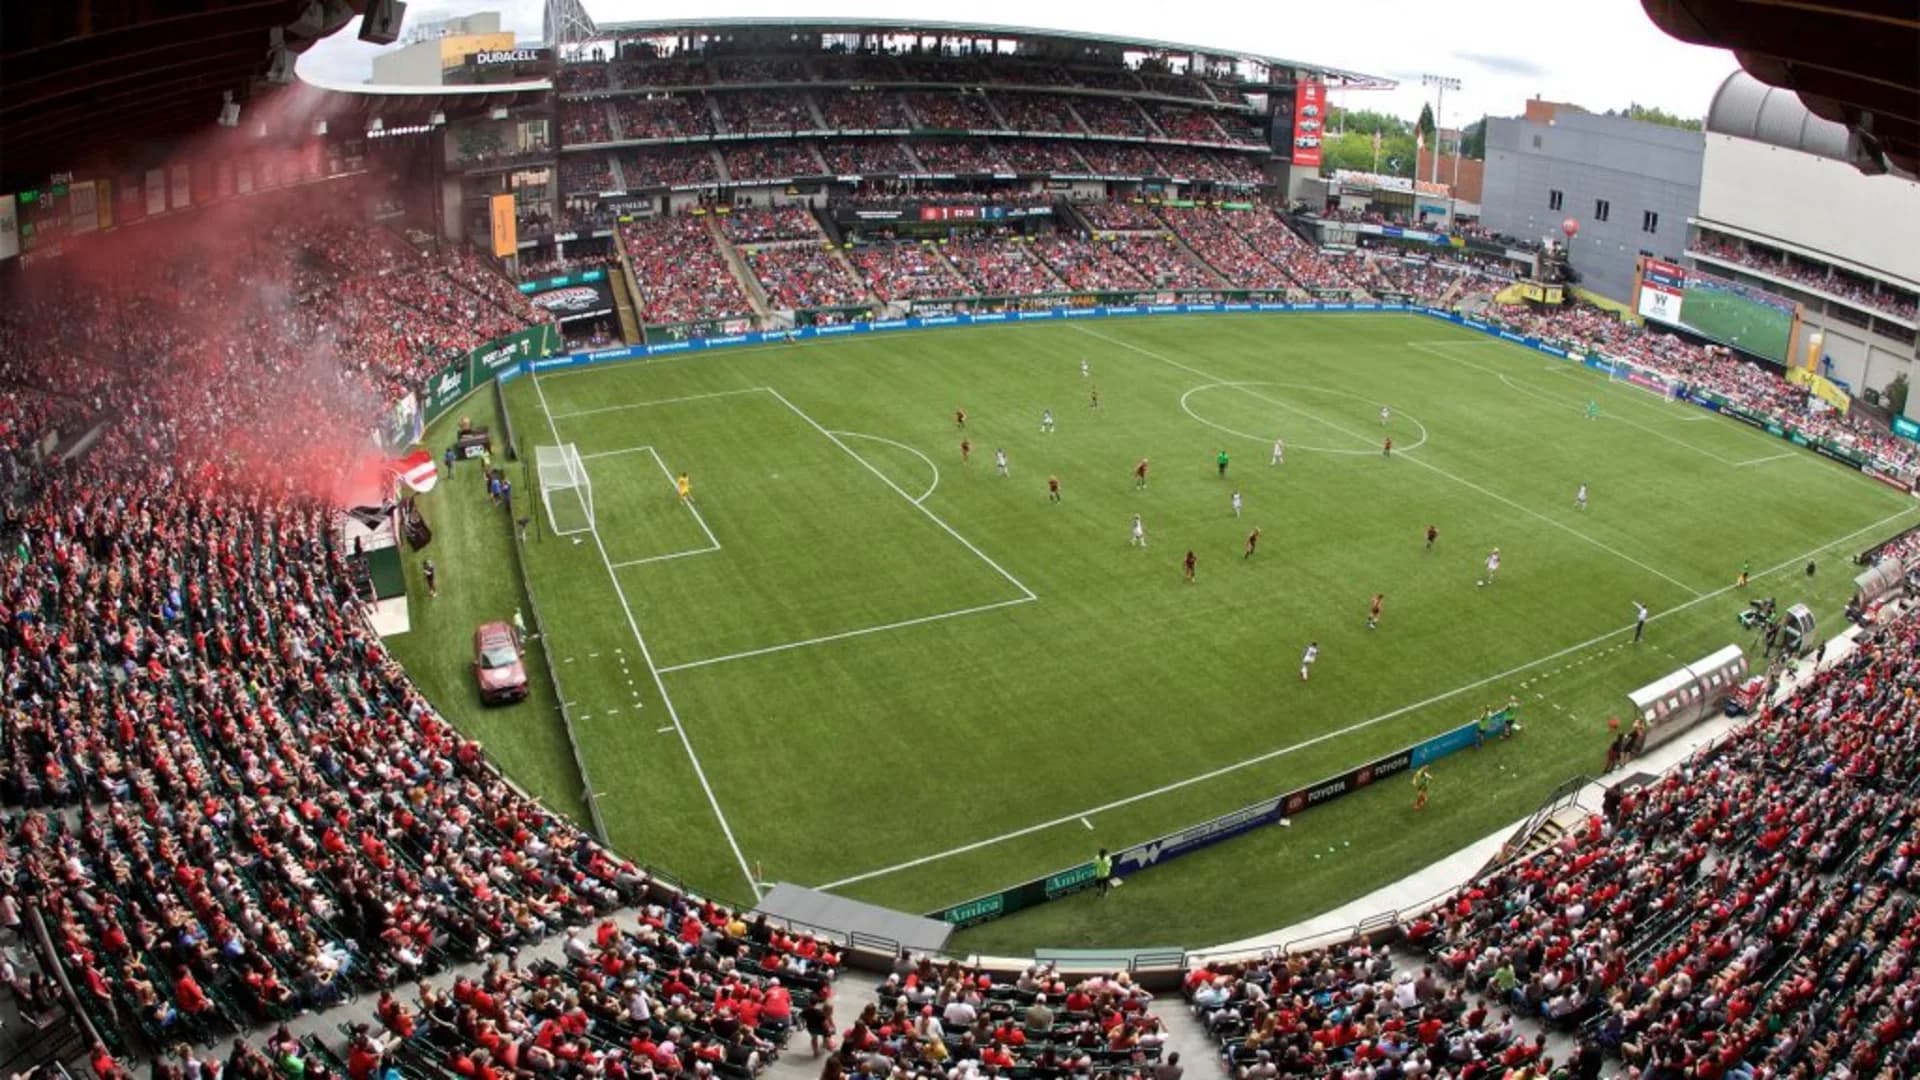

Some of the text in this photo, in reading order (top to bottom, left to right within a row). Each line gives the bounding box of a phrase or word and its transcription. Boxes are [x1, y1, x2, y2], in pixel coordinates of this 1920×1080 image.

[477, 50, 538, 65] DURACELL
[942, 207, 948, 220] 1
[981, 207, 987, 219] 1
[1375, 756, 1409, 776] TOYOTA
[1308, 781, 1346, 802] TOYOTA
[1052, 865, 1097, 890] Amica
[949, 899, 1000, 923] Amica
